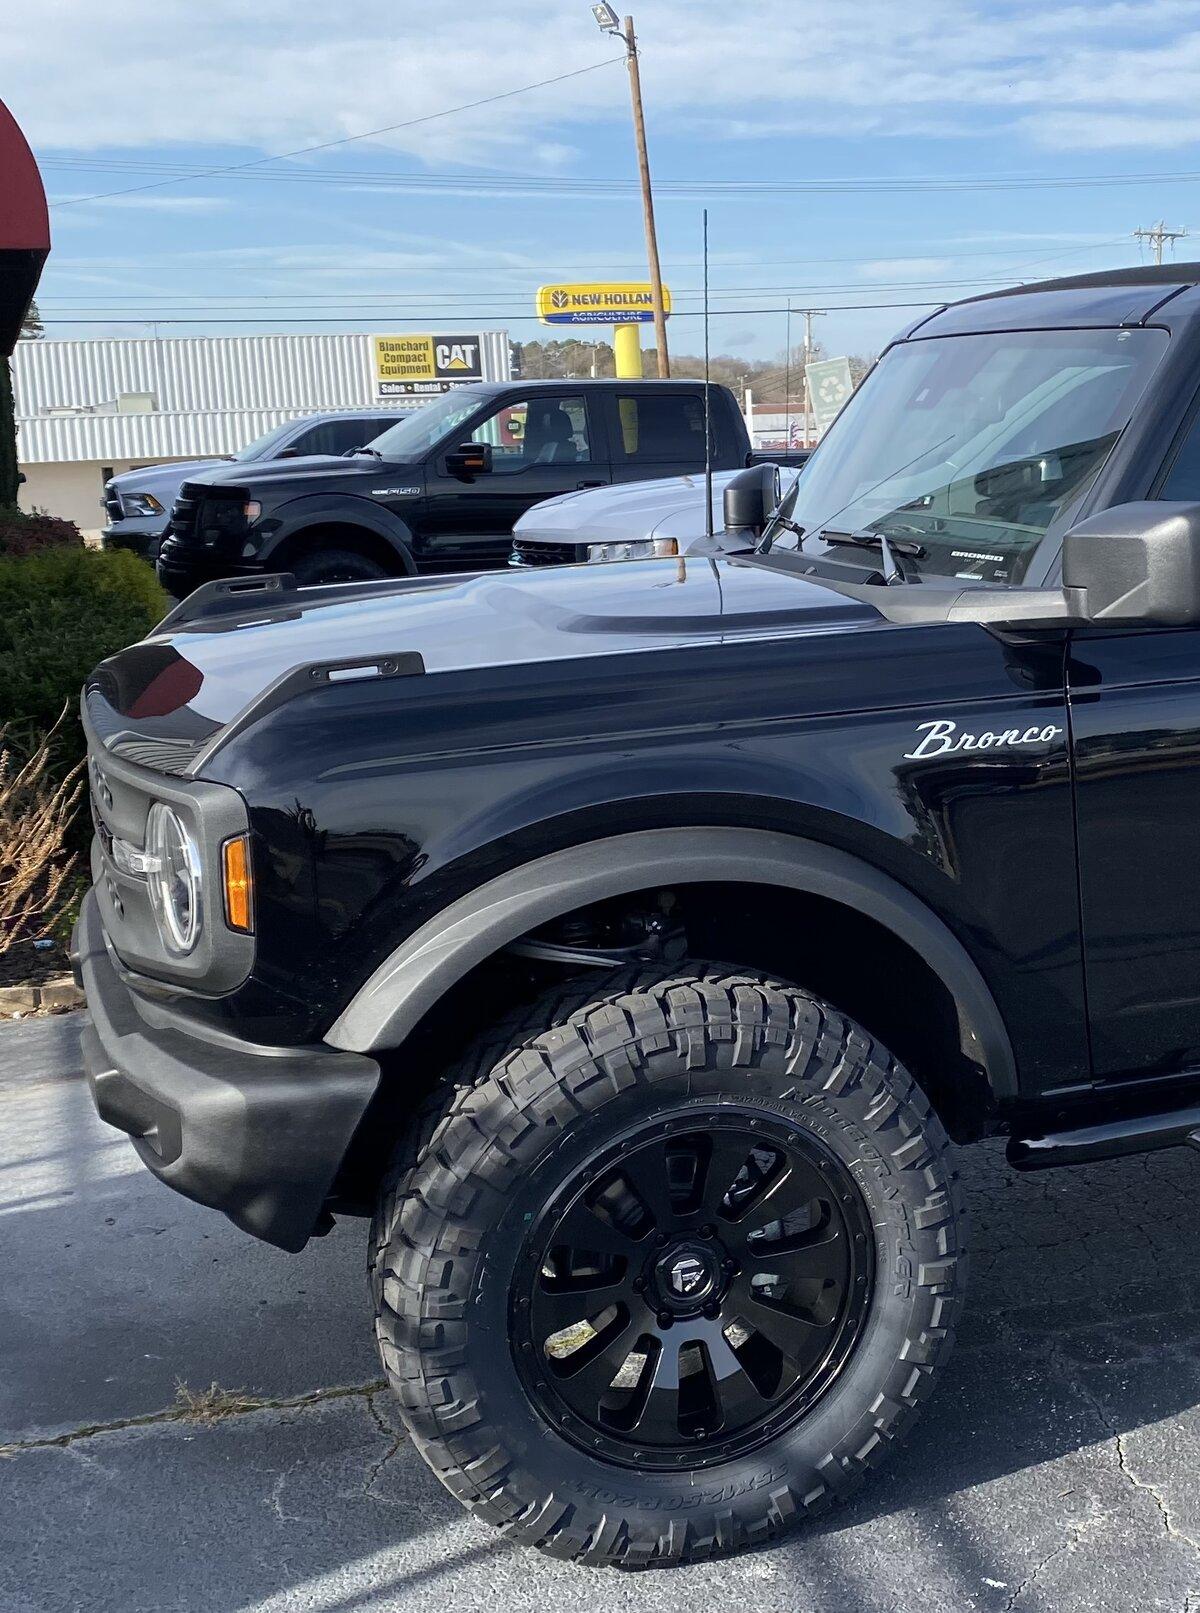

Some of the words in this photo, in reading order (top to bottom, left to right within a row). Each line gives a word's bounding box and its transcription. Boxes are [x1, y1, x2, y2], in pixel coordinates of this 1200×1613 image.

[571, 293, 600, 306] NEW
[603, 293, 654, 305] HOLLAN
[571, 311, 643, 322] AGRICULTURE
[379, 341, 429, 352] Blanchard
[383, 352, 427, 364] Compact
[435, 344, 475, 370] CAT
[380, 364, 432, 375] Equipment
[381, 383, 406, 394] Sales
[413, 382, 441, 393] Rental
[902, 720, 1063, 759] Bronco
